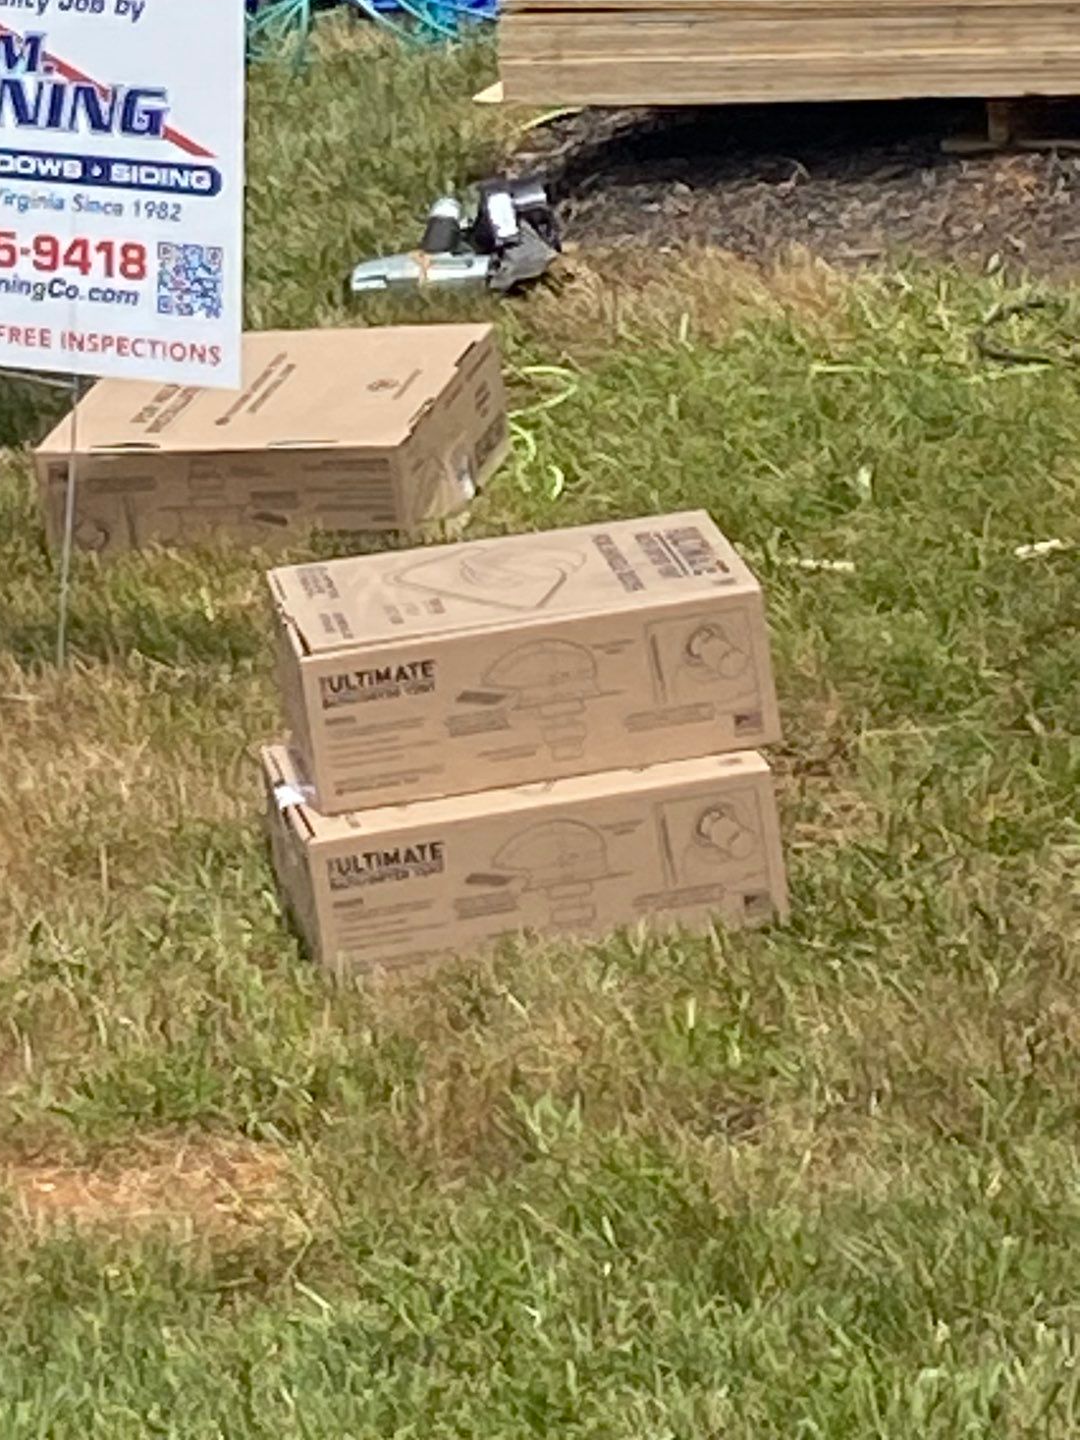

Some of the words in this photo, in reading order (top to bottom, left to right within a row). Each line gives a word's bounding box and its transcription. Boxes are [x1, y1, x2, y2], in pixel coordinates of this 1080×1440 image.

[110, 163, 214, 192] SIDING
[73, 194, 125, 218] Since
[134, 199, 183, 222] 1982
[60, 331, 224, 367] INSPECTIONS
[326, 659, 437, 694] ULTIMATE
[336, 841, 445, 877] ULTIMATE
